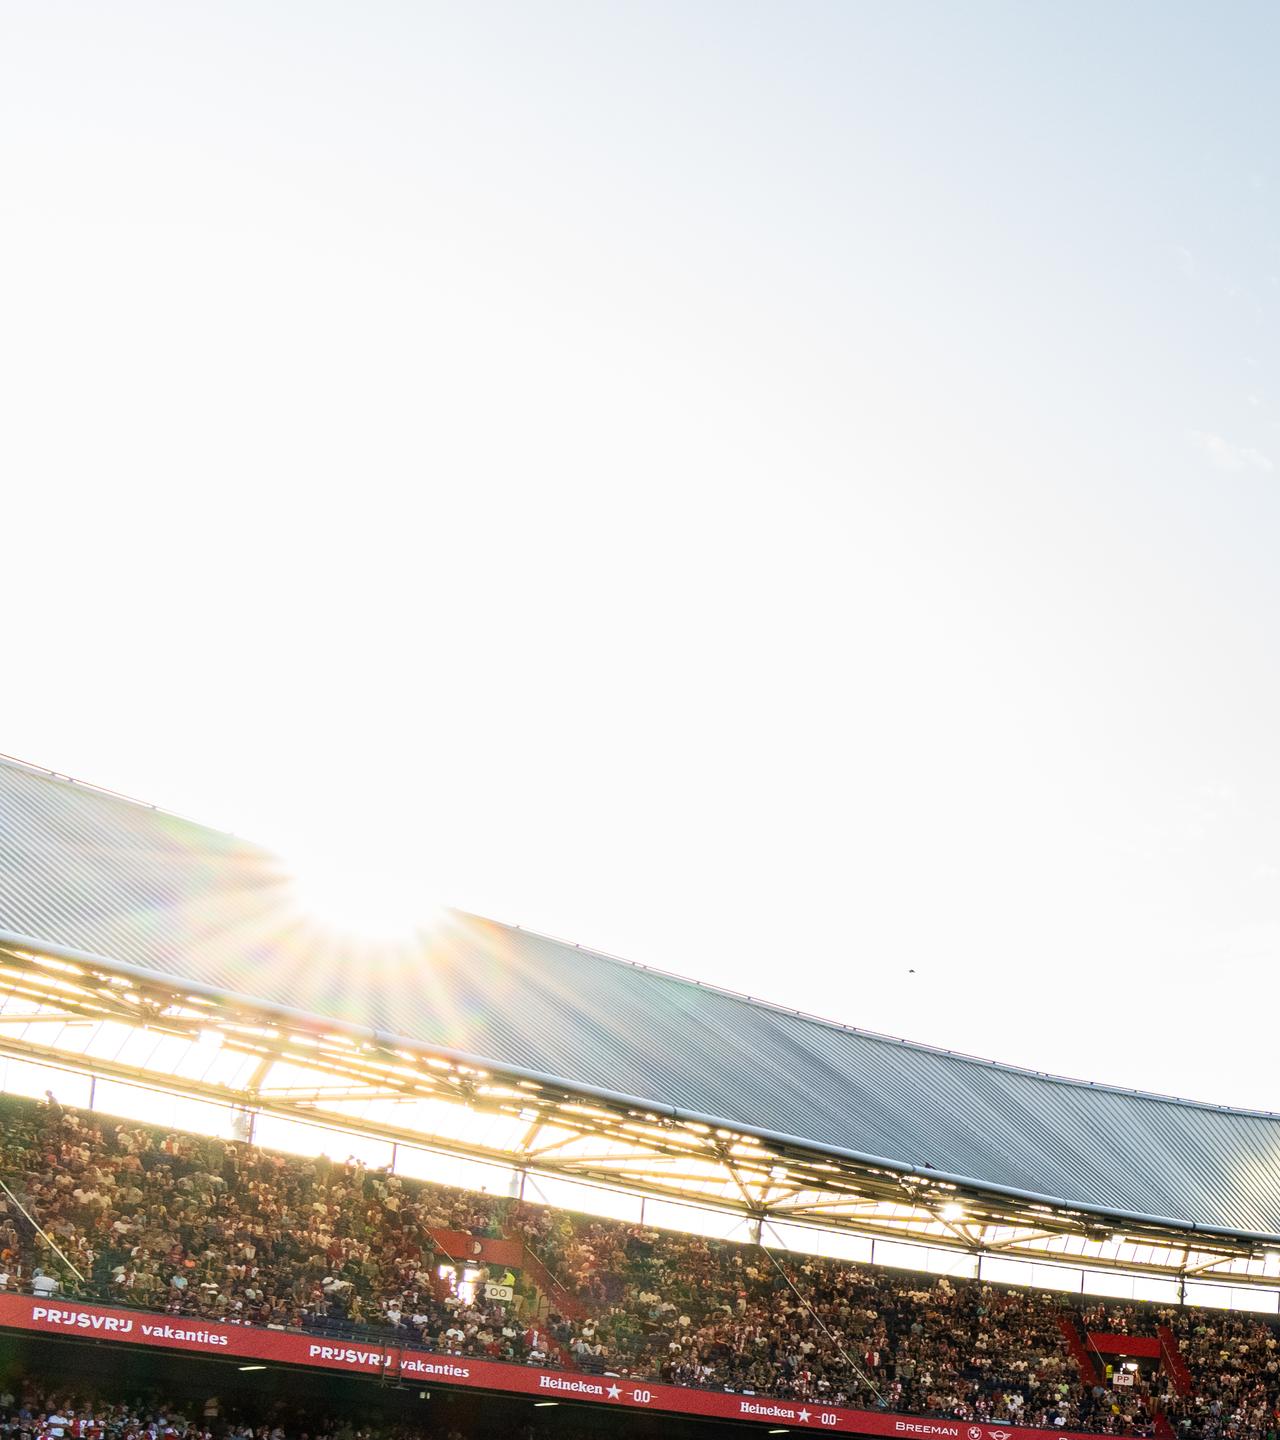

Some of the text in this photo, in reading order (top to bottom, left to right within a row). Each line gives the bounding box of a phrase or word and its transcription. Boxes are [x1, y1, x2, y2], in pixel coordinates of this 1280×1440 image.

[142, 1324, 228, 1346] vakanties
[400, 1359, 470, 1379] vakanties
[540, 1376, 604, 1396] Heineken
[740, 1401, 795, 1419] Heineken
[895, 1421, 959, 1437] BREEMAN
